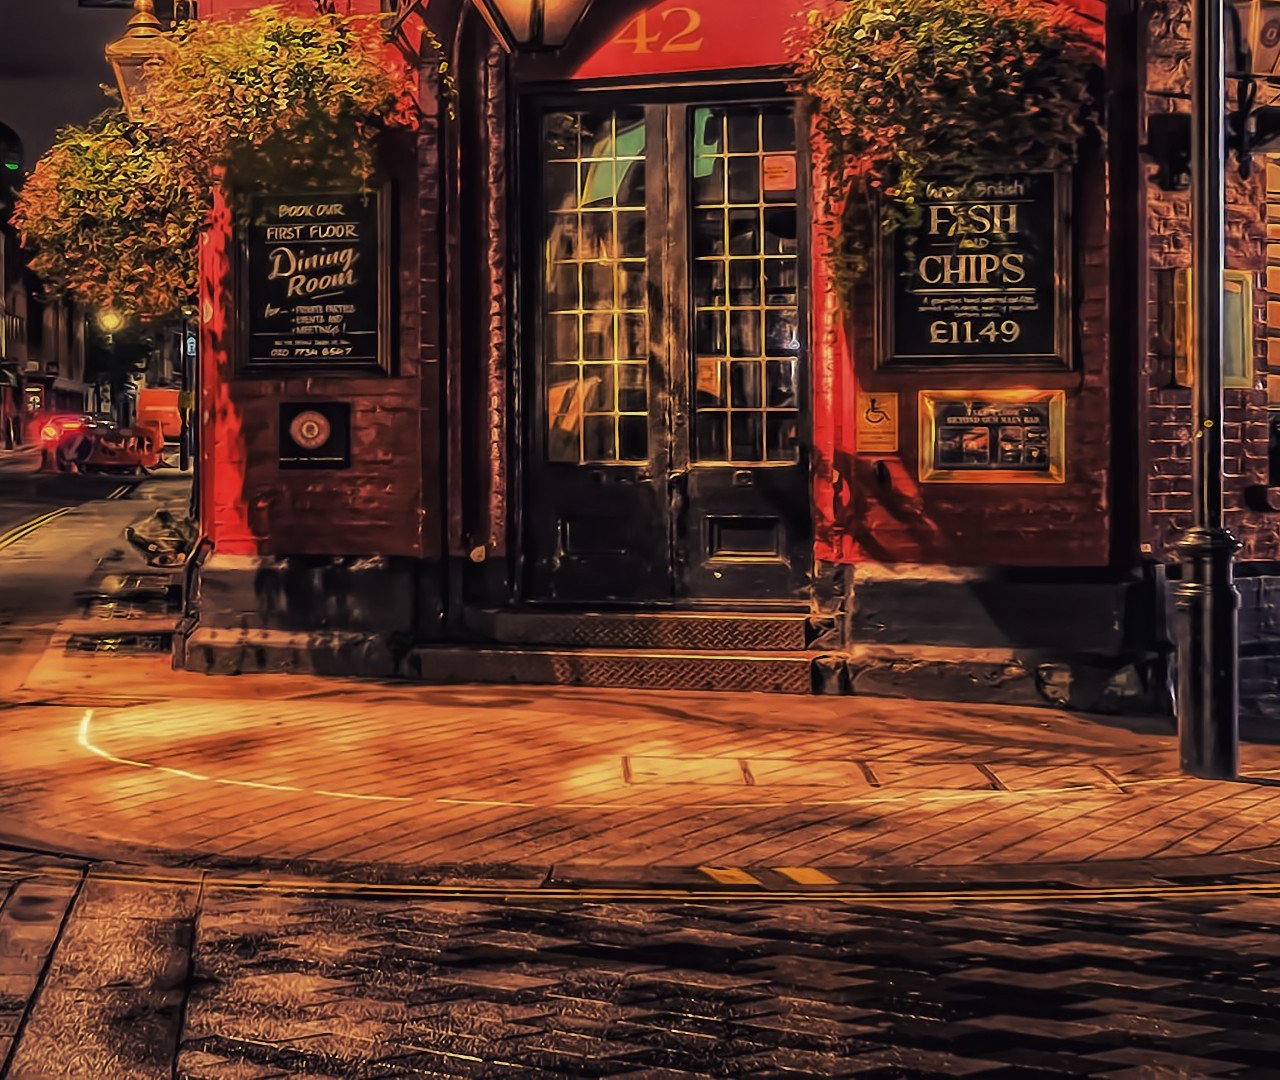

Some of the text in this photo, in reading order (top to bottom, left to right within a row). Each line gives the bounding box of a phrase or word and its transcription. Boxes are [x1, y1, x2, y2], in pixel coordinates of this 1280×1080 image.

[611, 7, 704, 53] 42
[278, 204, 345, 218] BOOK OUR
[266, 224, 360, 240] FIRST FLOOR
[268, 246, 360, 280] Dining
[919, 253, 1026, 284] CHIPS
[287, 269, 358, 297] Room
[929, 320, 1021, 344] £11.49
